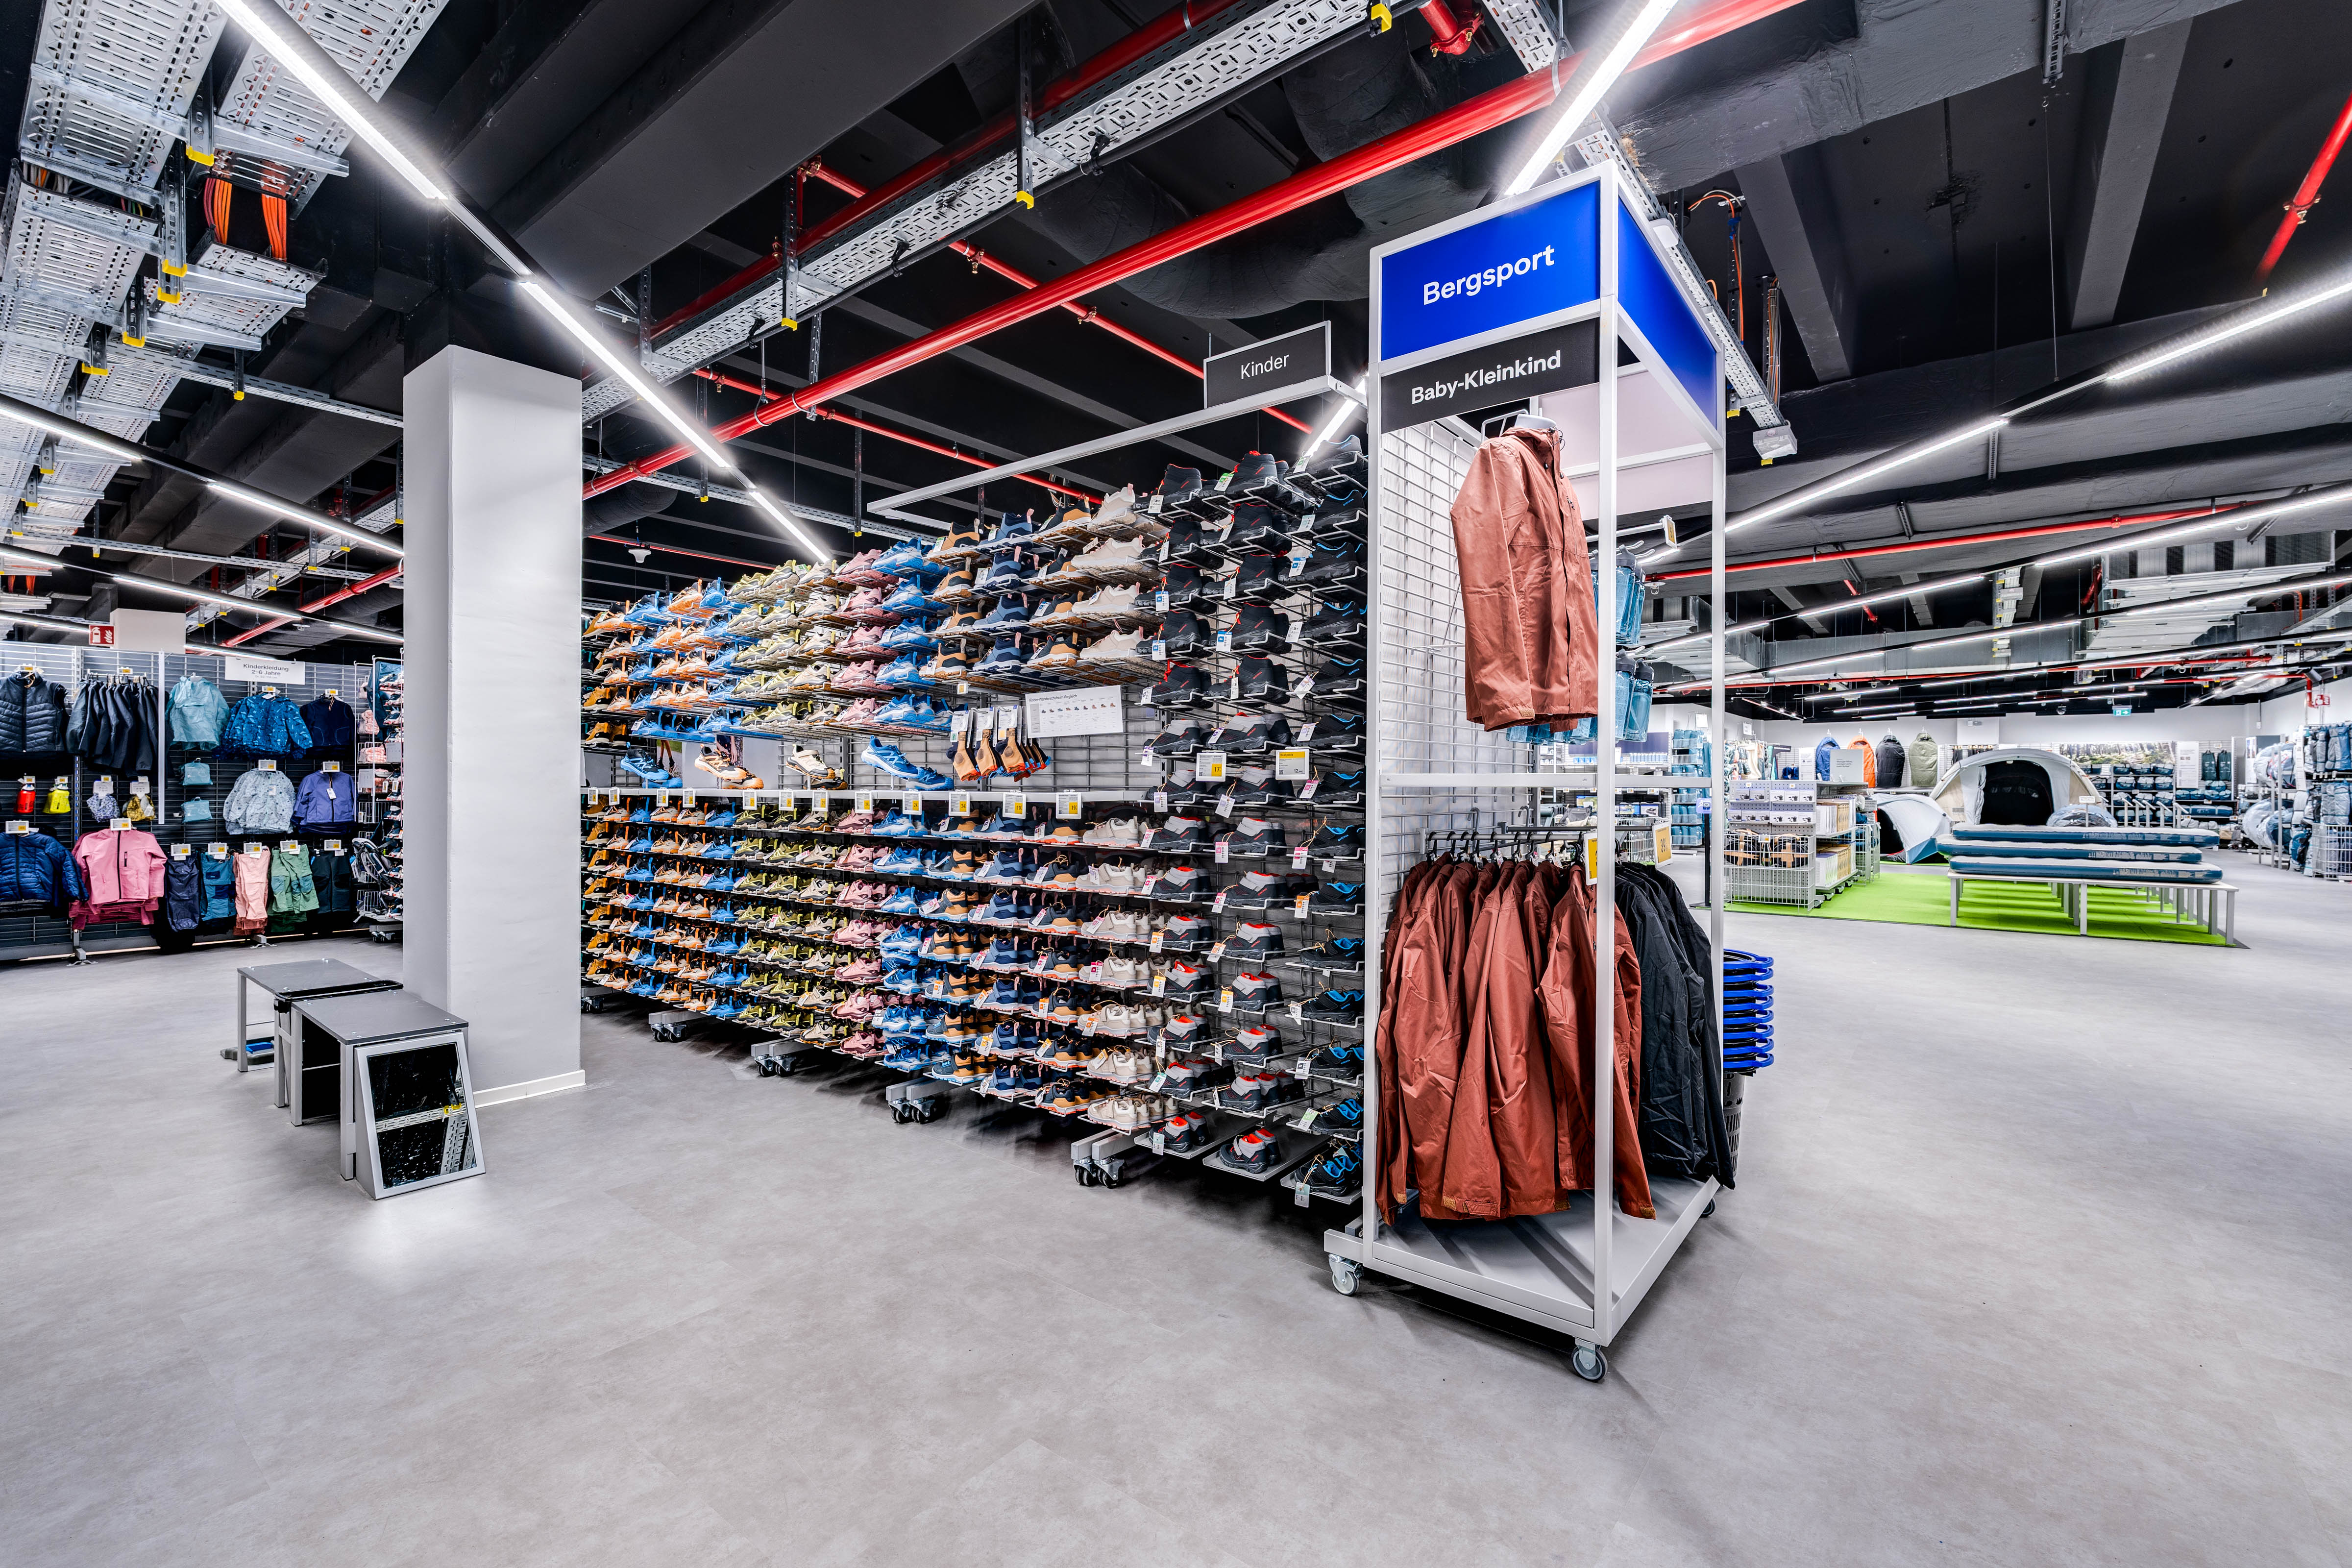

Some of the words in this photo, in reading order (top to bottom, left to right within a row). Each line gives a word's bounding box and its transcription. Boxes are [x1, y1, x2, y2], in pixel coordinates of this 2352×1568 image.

[1423, 245, 1555, 305] Bergsport
[1241, 353, 1290, 379] Kinder
[1412, 350, 1561, 405] Baby-Kleinkind
